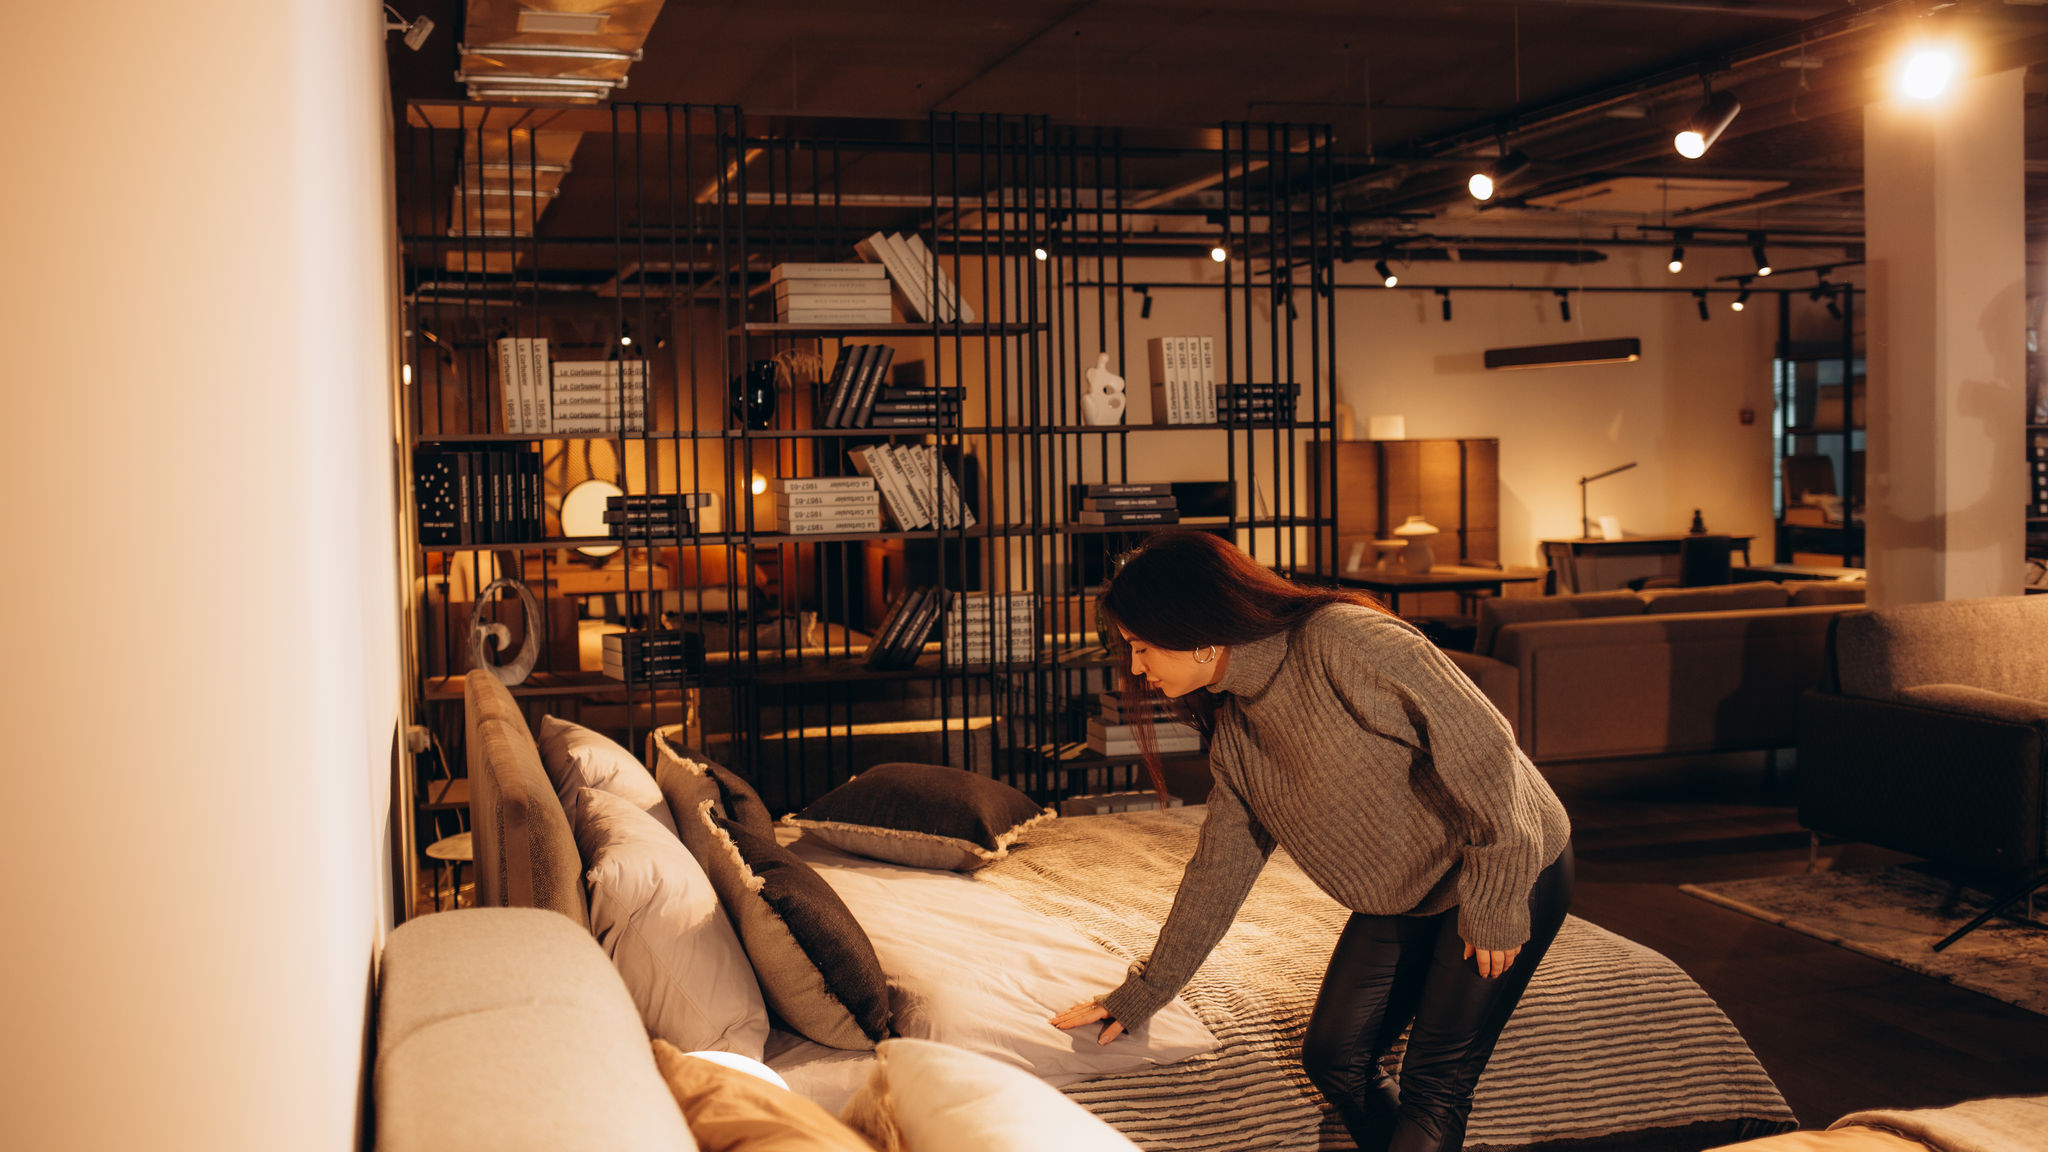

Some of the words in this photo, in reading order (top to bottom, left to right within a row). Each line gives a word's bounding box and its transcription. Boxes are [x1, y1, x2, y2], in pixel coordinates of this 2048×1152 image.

[502, 344, 508, 352] Le
[519, 344, 525, 352] Le
[535, 344, 540, 352] Le
[560, 368, 568, 376] Le
[570, 368, 602, 376] Corbusier
[560, 383, 567, 391] Le
[570, 382, 601, 391] Corbusier
[1171, 411, 1177, 419] Le
[1184, 411, 1190, 419] Le
[1196, 411, 1201, 419] Le
[559, 426, 566, 434] Le
[888, 490, 905, 517] Corbusier
[902, 516, 910, 526] Le
